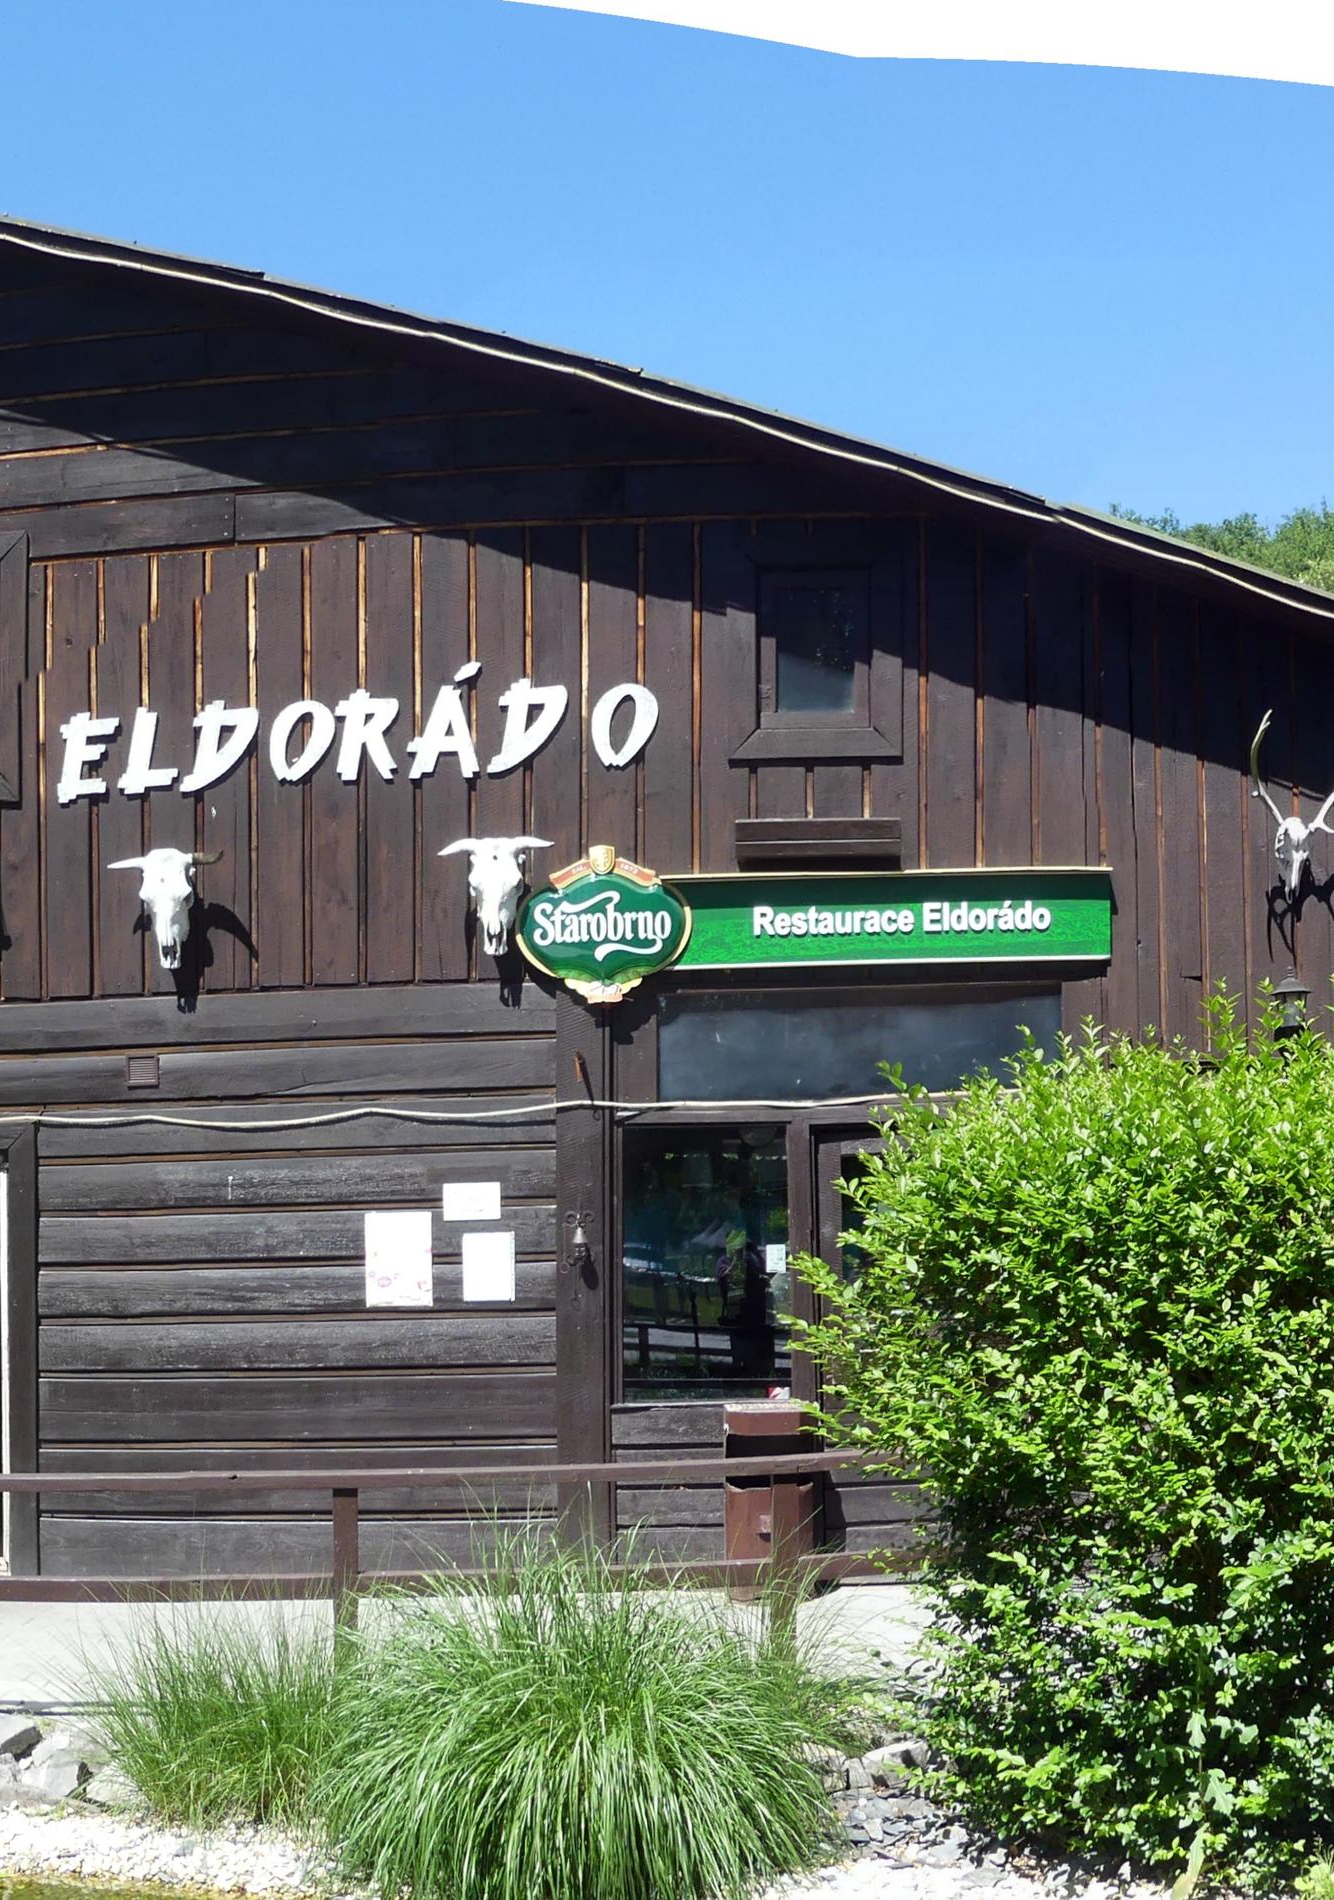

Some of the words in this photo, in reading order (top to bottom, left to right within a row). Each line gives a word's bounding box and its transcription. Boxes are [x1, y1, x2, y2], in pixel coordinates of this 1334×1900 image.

[57, 661, 659, 804] ELDORÁDO
[533, 890, 671, 962] Starobrno
[753, 905, 915, 937] Restaurace
[922, 900, 1052, 933] Eldorádo
